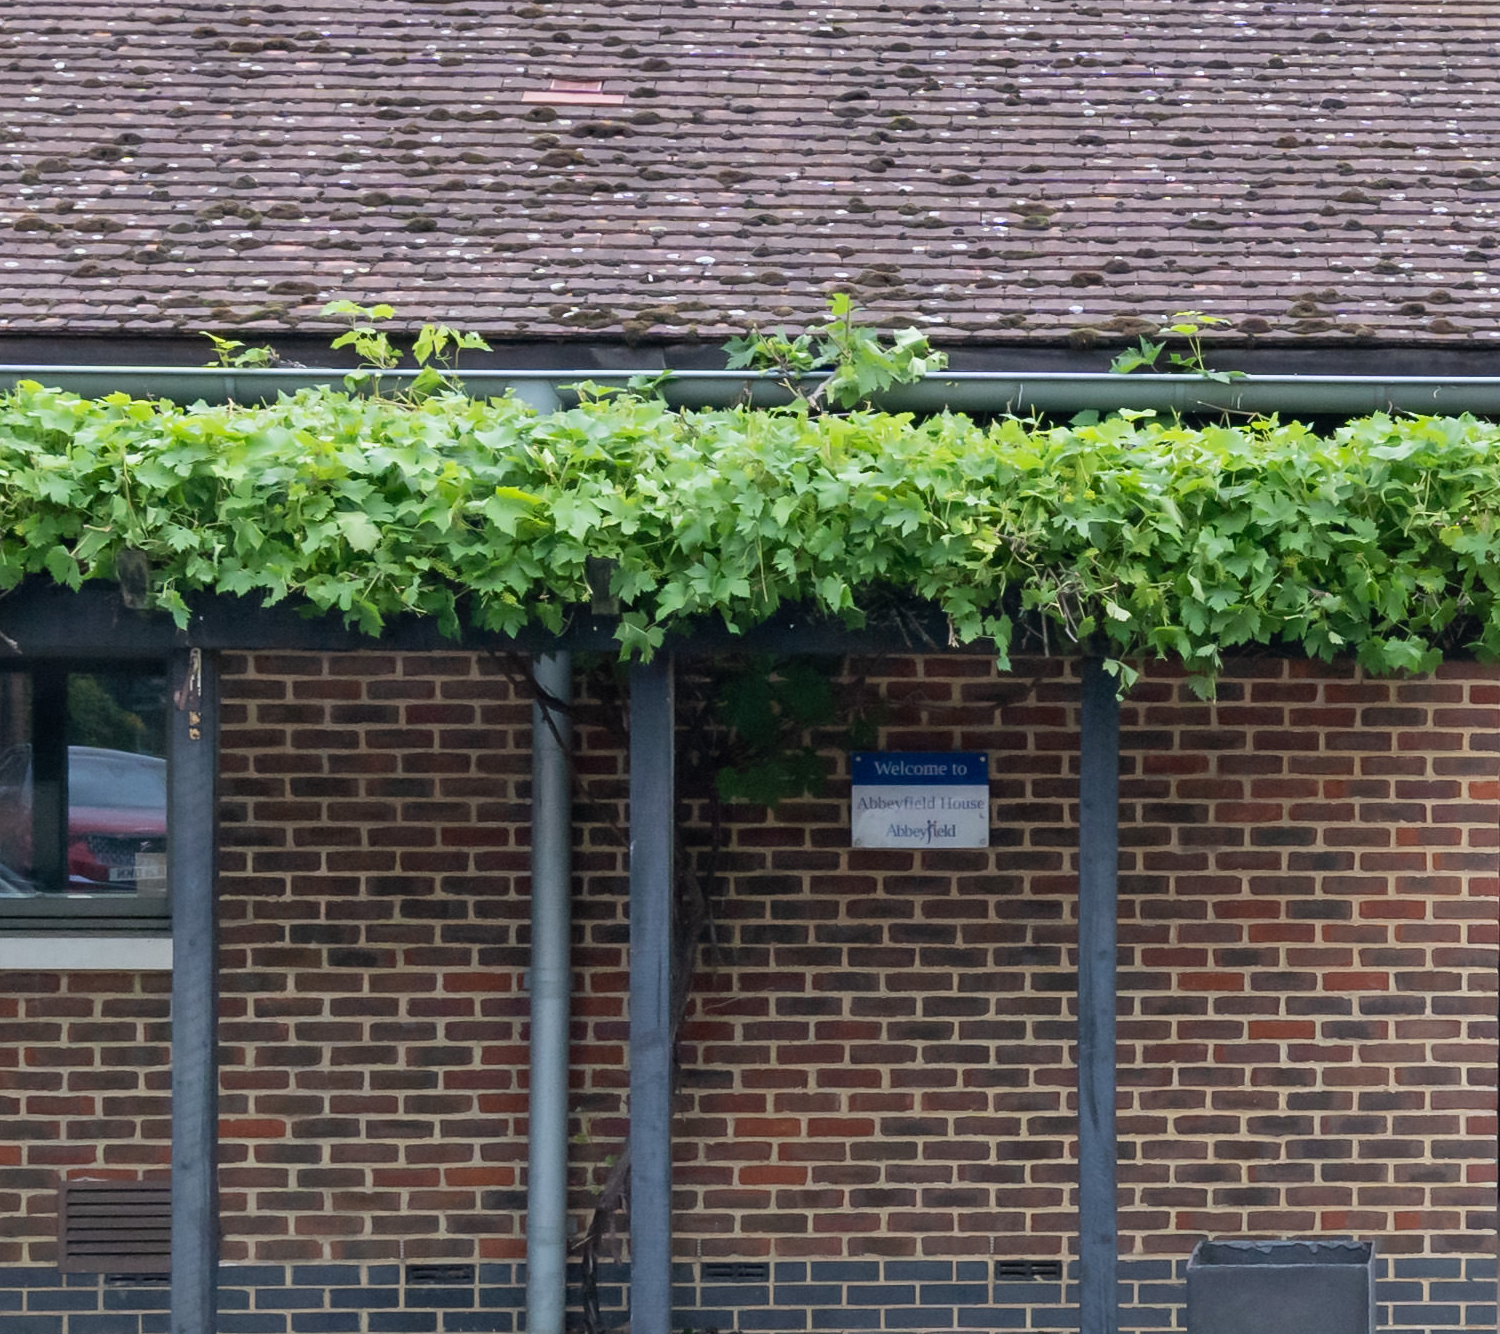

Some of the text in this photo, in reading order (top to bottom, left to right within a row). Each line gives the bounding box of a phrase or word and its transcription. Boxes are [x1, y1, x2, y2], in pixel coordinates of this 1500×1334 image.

[874, 760, 967, 776] Welcome to
[858, 796, 985, 812] Abbeyfield House
[886, 819, 956, 844] Abbeyfield
